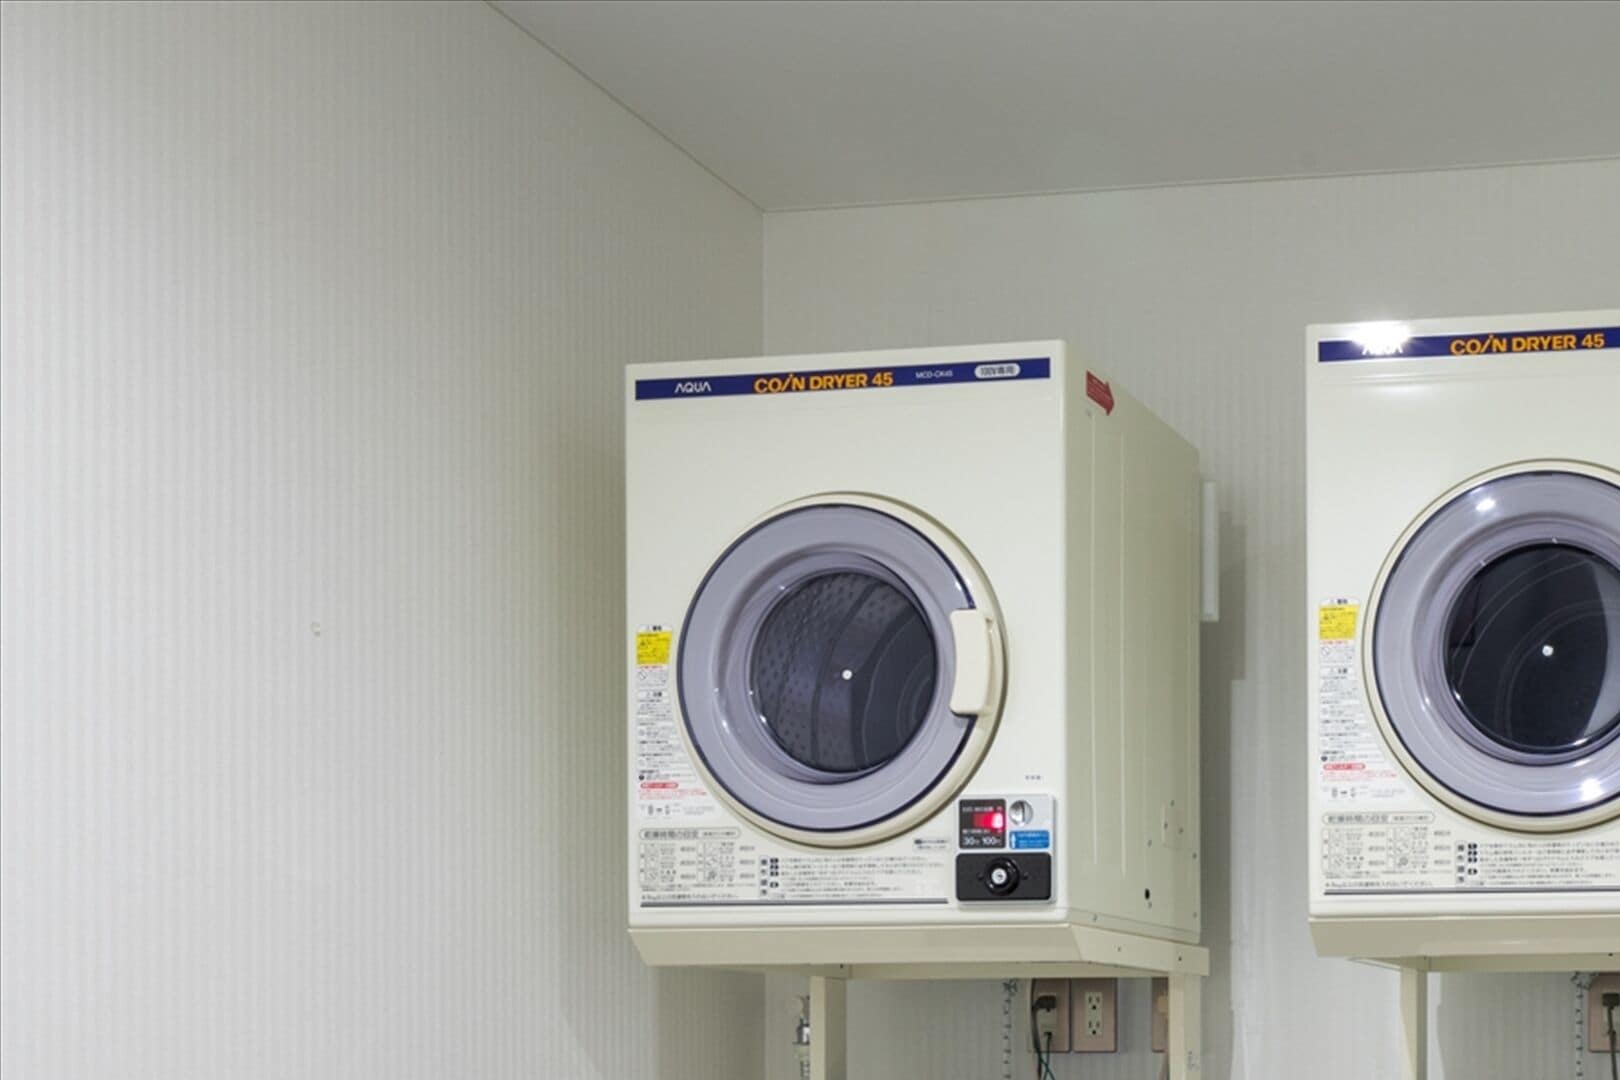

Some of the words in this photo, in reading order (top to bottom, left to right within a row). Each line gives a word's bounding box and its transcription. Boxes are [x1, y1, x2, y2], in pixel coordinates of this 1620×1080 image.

[1511, 335, 1576, 352] DRYER
[1581, 333, 1605, 349] 45
[674, 381, 712, 394] AQUA
[810, 374, 869, 391] DRYER
[872, 372, 894, 387] 45
